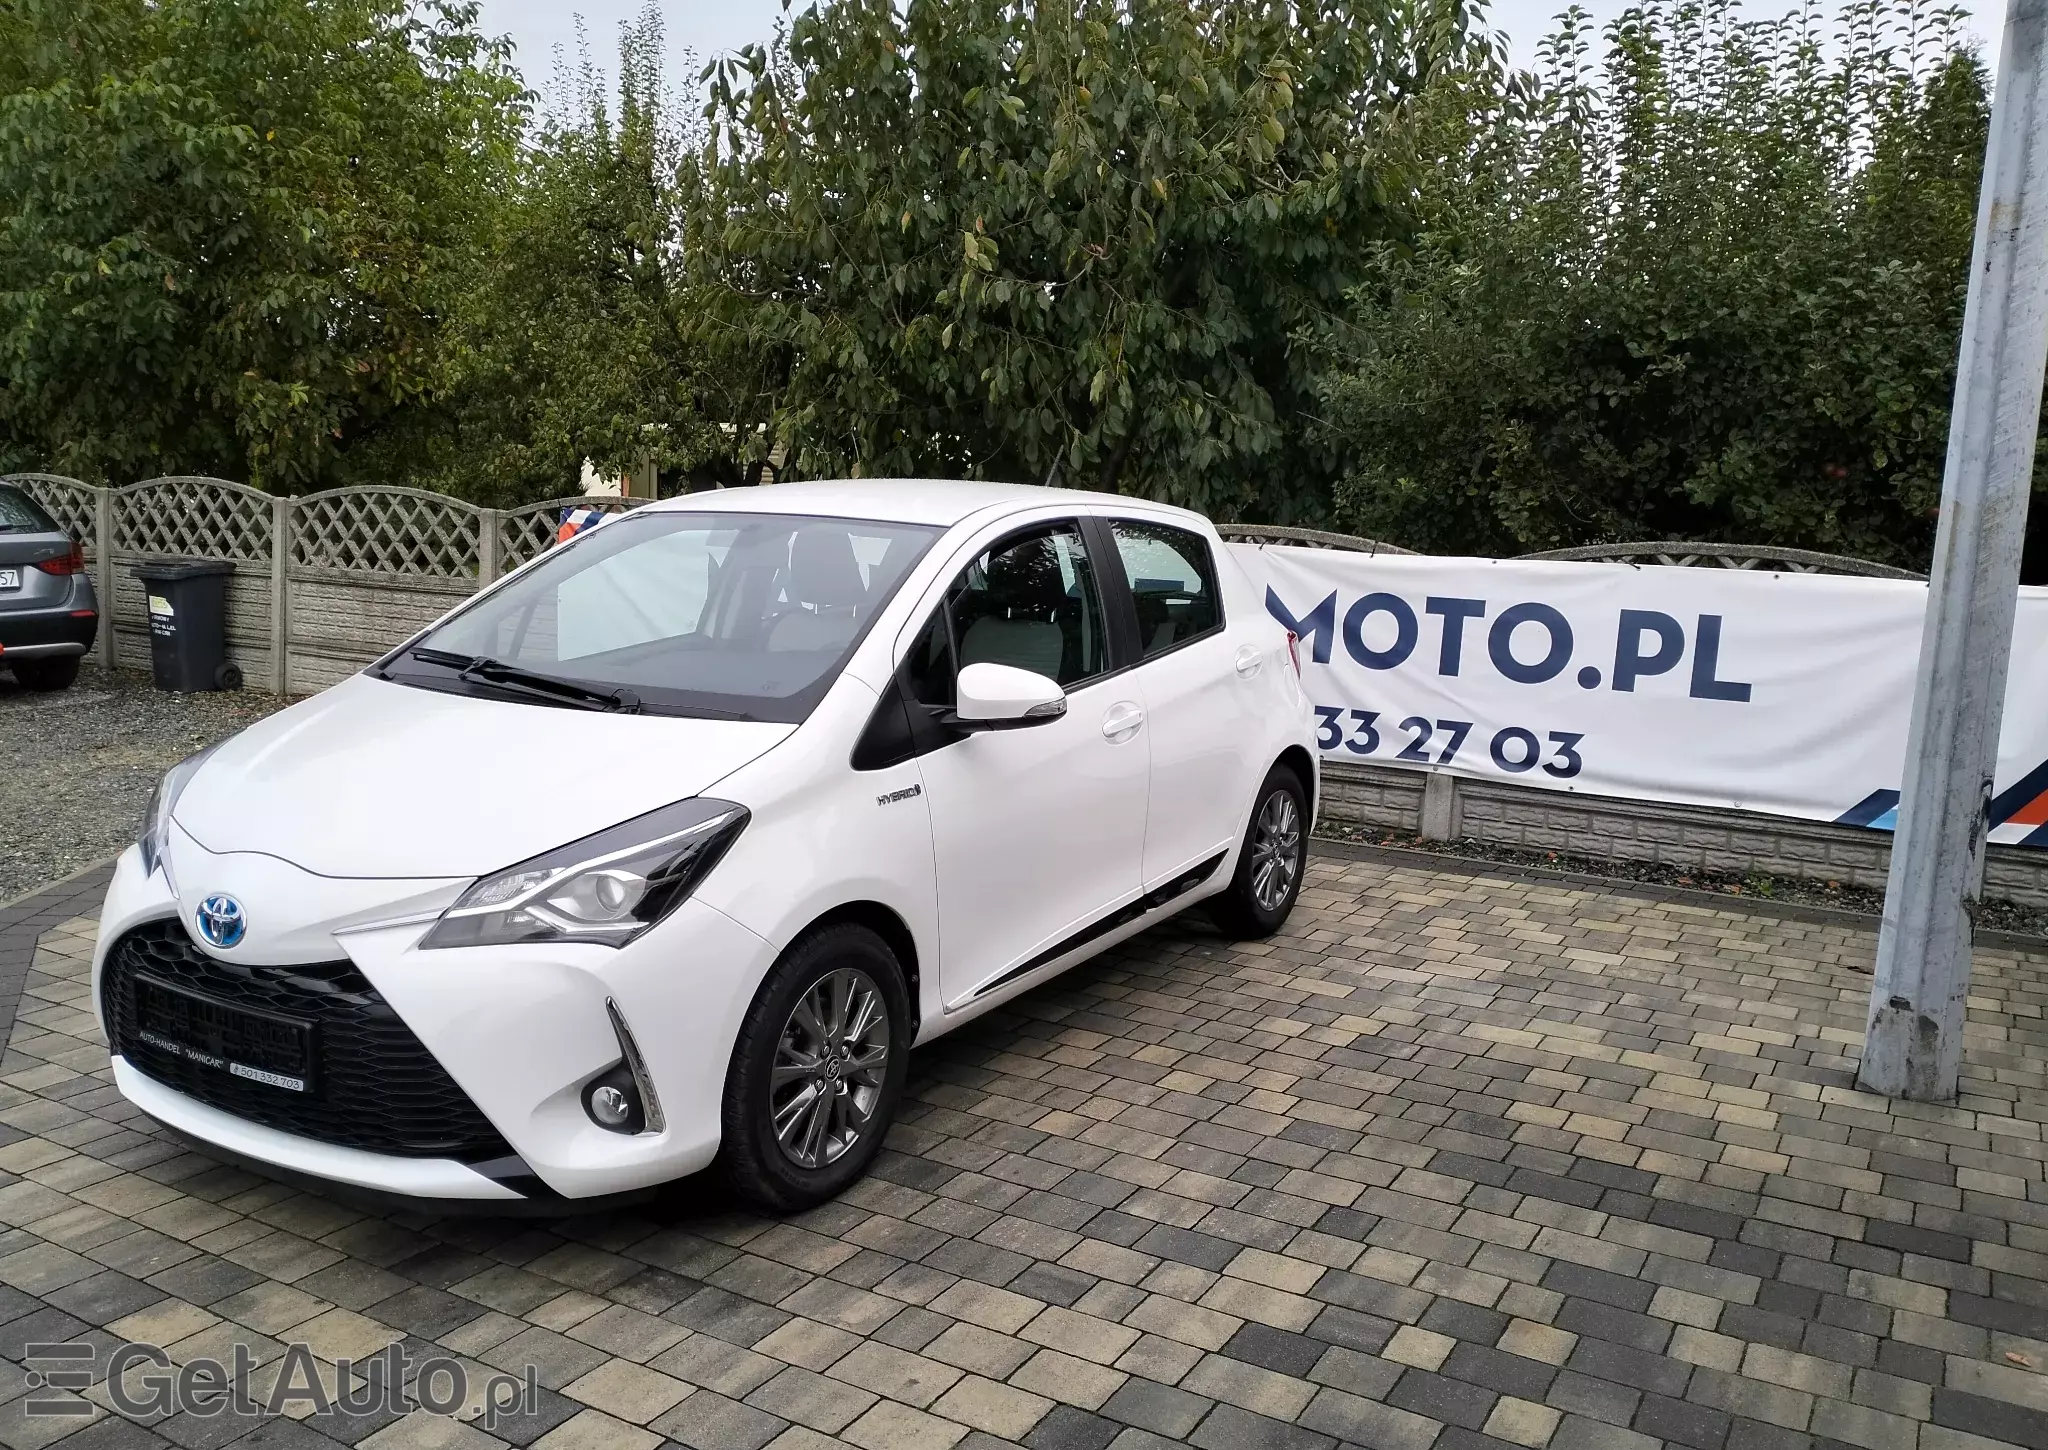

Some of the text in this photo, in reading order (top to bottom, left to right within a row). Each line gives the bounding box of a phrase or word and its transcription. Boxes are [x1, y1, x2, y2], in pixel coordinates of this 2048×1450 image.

[1265, 582, 1753, 703] MOTO.PL
[1314, 705, 1586, 779] 33 27 03
[876, 787, 915, 806] HYBRID
[139, 1031, 181, 1055] AUTO-HANDEL
